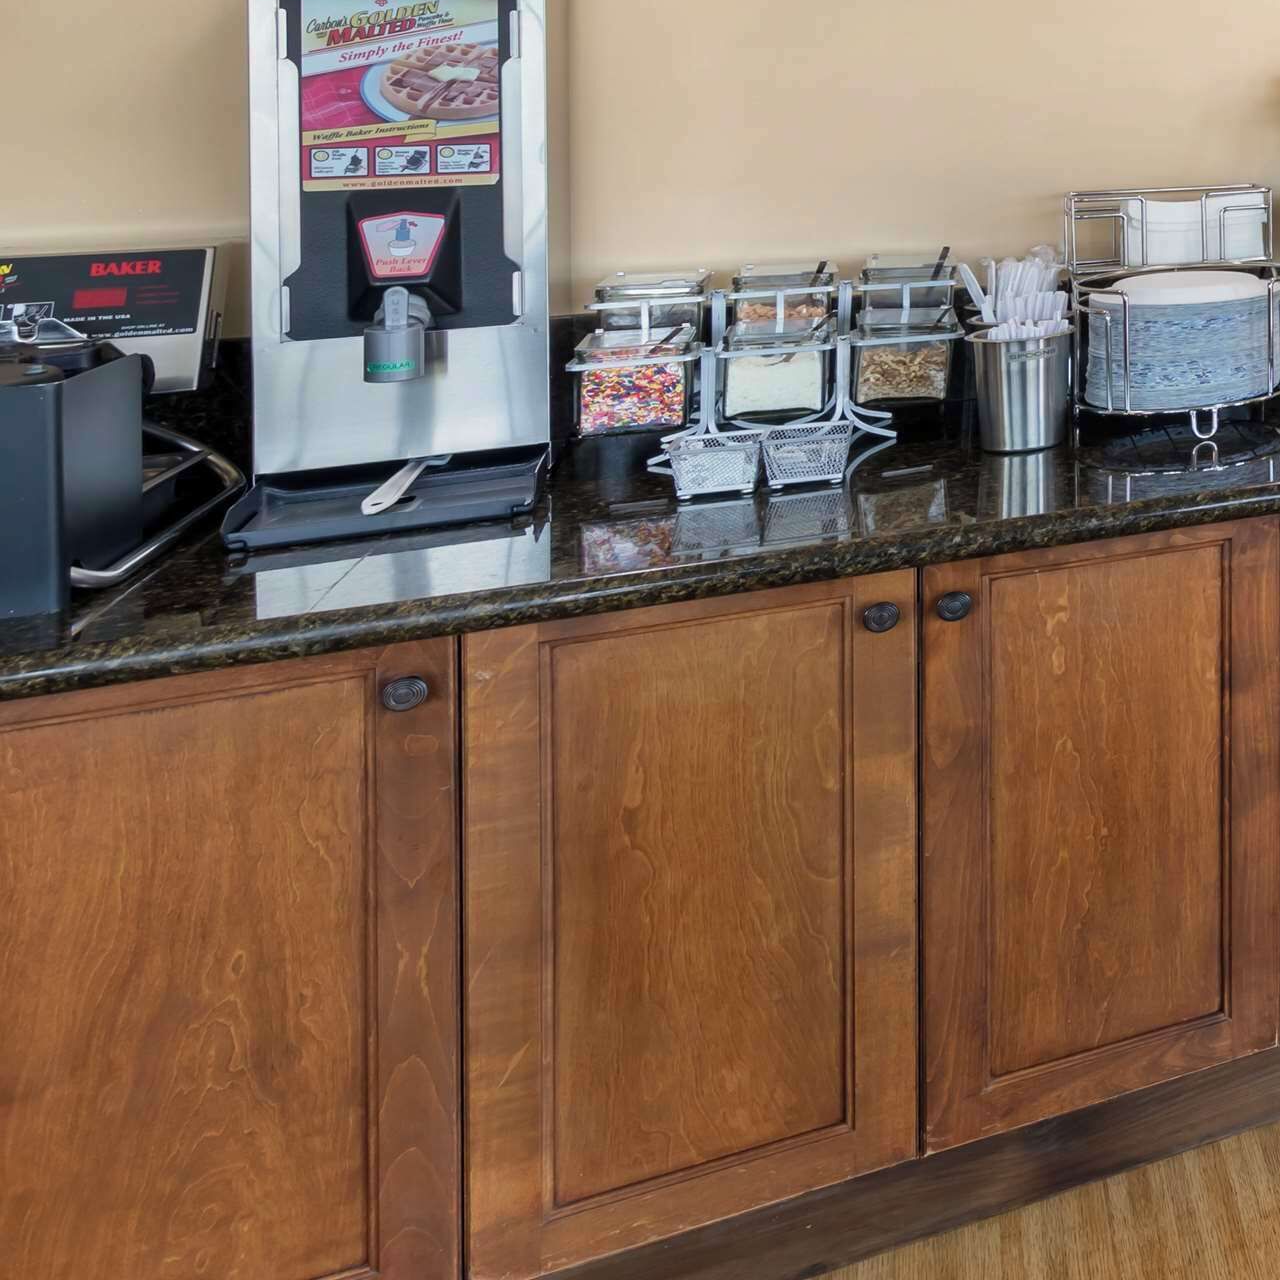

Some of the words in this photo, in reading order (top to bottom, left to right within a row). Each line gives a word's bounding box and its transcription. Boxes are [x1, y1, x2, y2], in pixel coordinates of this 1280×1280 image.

[306, 15, 348, 34] Carbon's
[350, 0, 440, 28] GOLDEN
[326, 17, 417, 46] MALTED
[338, 46, 389, 63] Simply
[392, 41, 414, 53] the
[417, 31, 464, 47] Finest!
[313, 131, 344, 141] Waffle
[345, 127, 373, 138] Baker
[375, 123, 430, 134] Instructions
[89, 260, 162, 277] BAKER
[388, 265, 411, 273] Back
[401, 256, 426, 265] Lever
